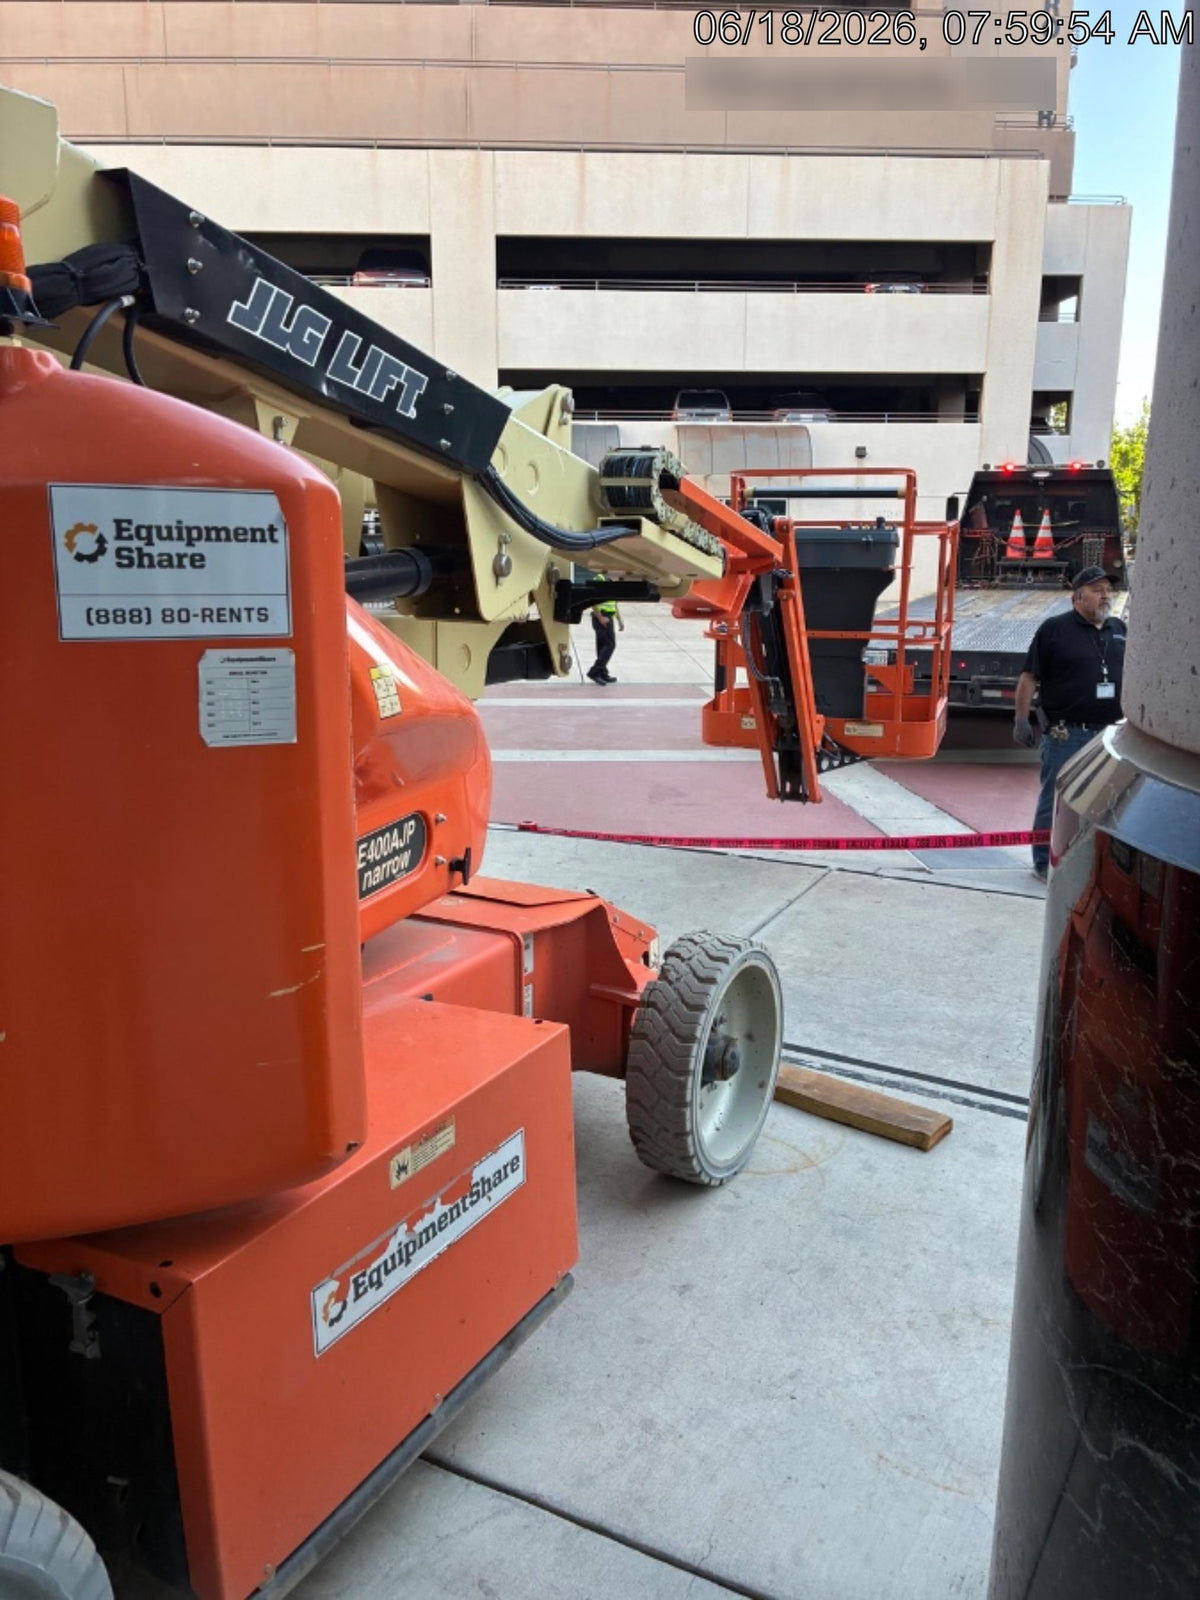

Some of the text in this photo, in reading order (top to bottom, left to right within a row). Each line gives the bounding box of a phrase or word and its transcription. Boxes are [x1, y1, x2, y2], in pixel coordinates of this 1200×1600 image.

[227, 277, 428, 419] JLG LIFT
[113, 518, 279, 547] Equipment
[115, 546, 206, 569] Share
[86, 607, 269, 626] (888) 80-RENTS
[357, 819, 416, 870] E400AJP
[362, 849, 411, 891] narrow
[352, 1154, 520, 1303] EquipmentShare
